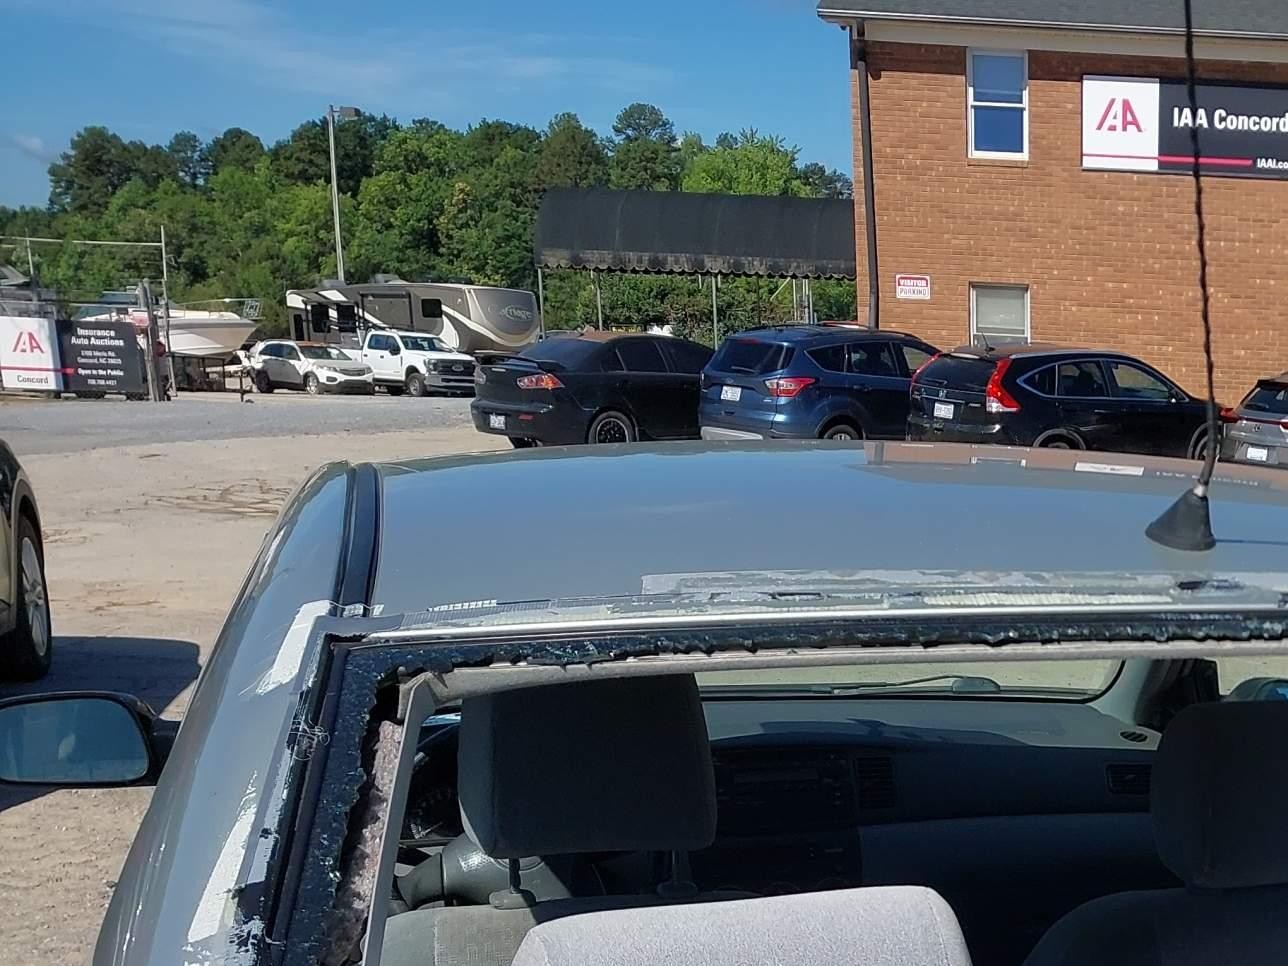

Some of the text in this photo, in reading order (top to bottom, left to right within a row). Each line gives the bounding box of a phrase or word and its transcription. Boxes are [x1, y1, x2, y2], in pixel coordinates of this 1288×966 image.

[1173, 107, 1209, 128] IAA
[899, 288, 927, 296] PARKING
[76, 327, 116, 337] Insurance
[71, 336, 124, 346] Auto Auctions
[17, 375, 49, 384] Concord
